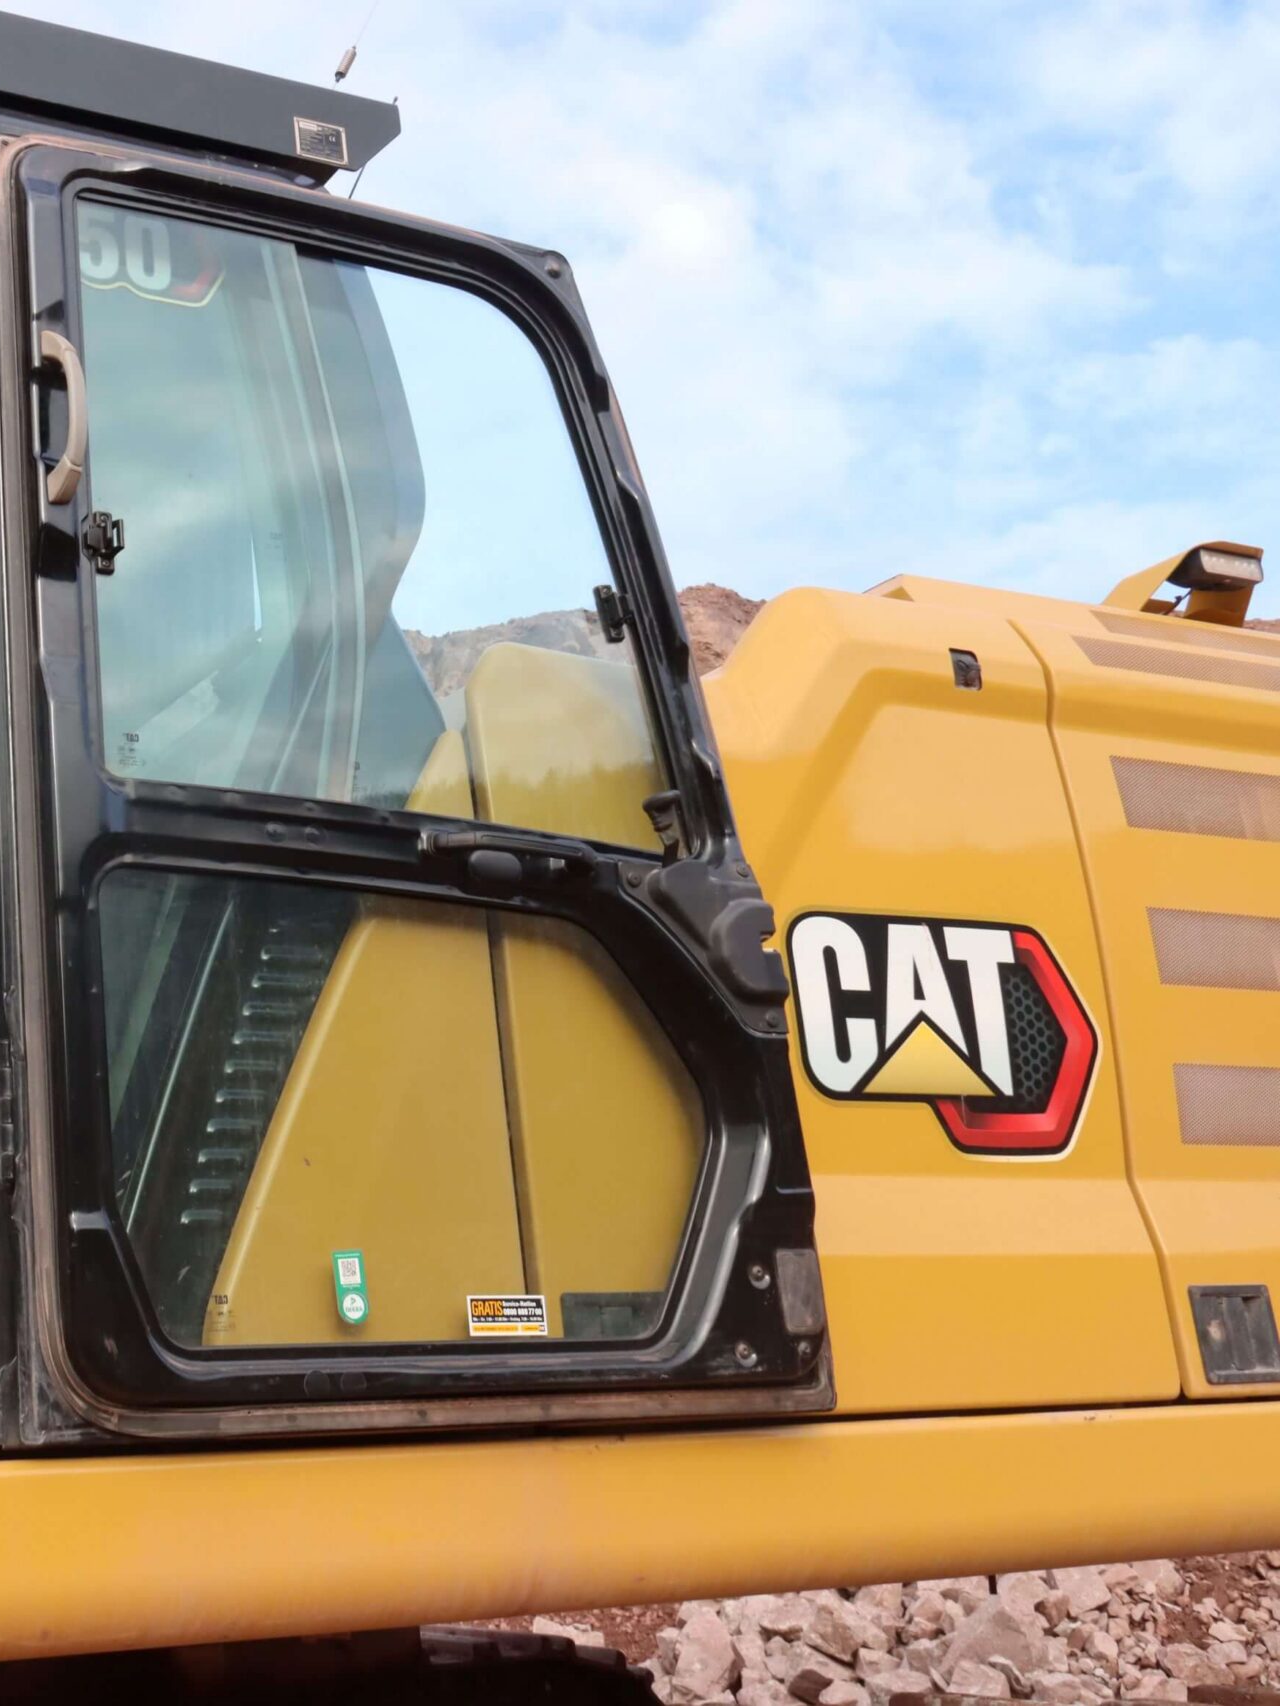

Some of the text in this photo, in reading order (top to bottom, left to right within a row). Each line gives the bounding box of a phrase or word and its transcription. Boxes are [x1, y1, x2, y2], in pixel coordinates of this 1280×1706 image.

[791, 916, 1015, 1096] CAT
[472, 1300, 503, 1316] GRATIS
[528, 1308, 535, 1316] 77
